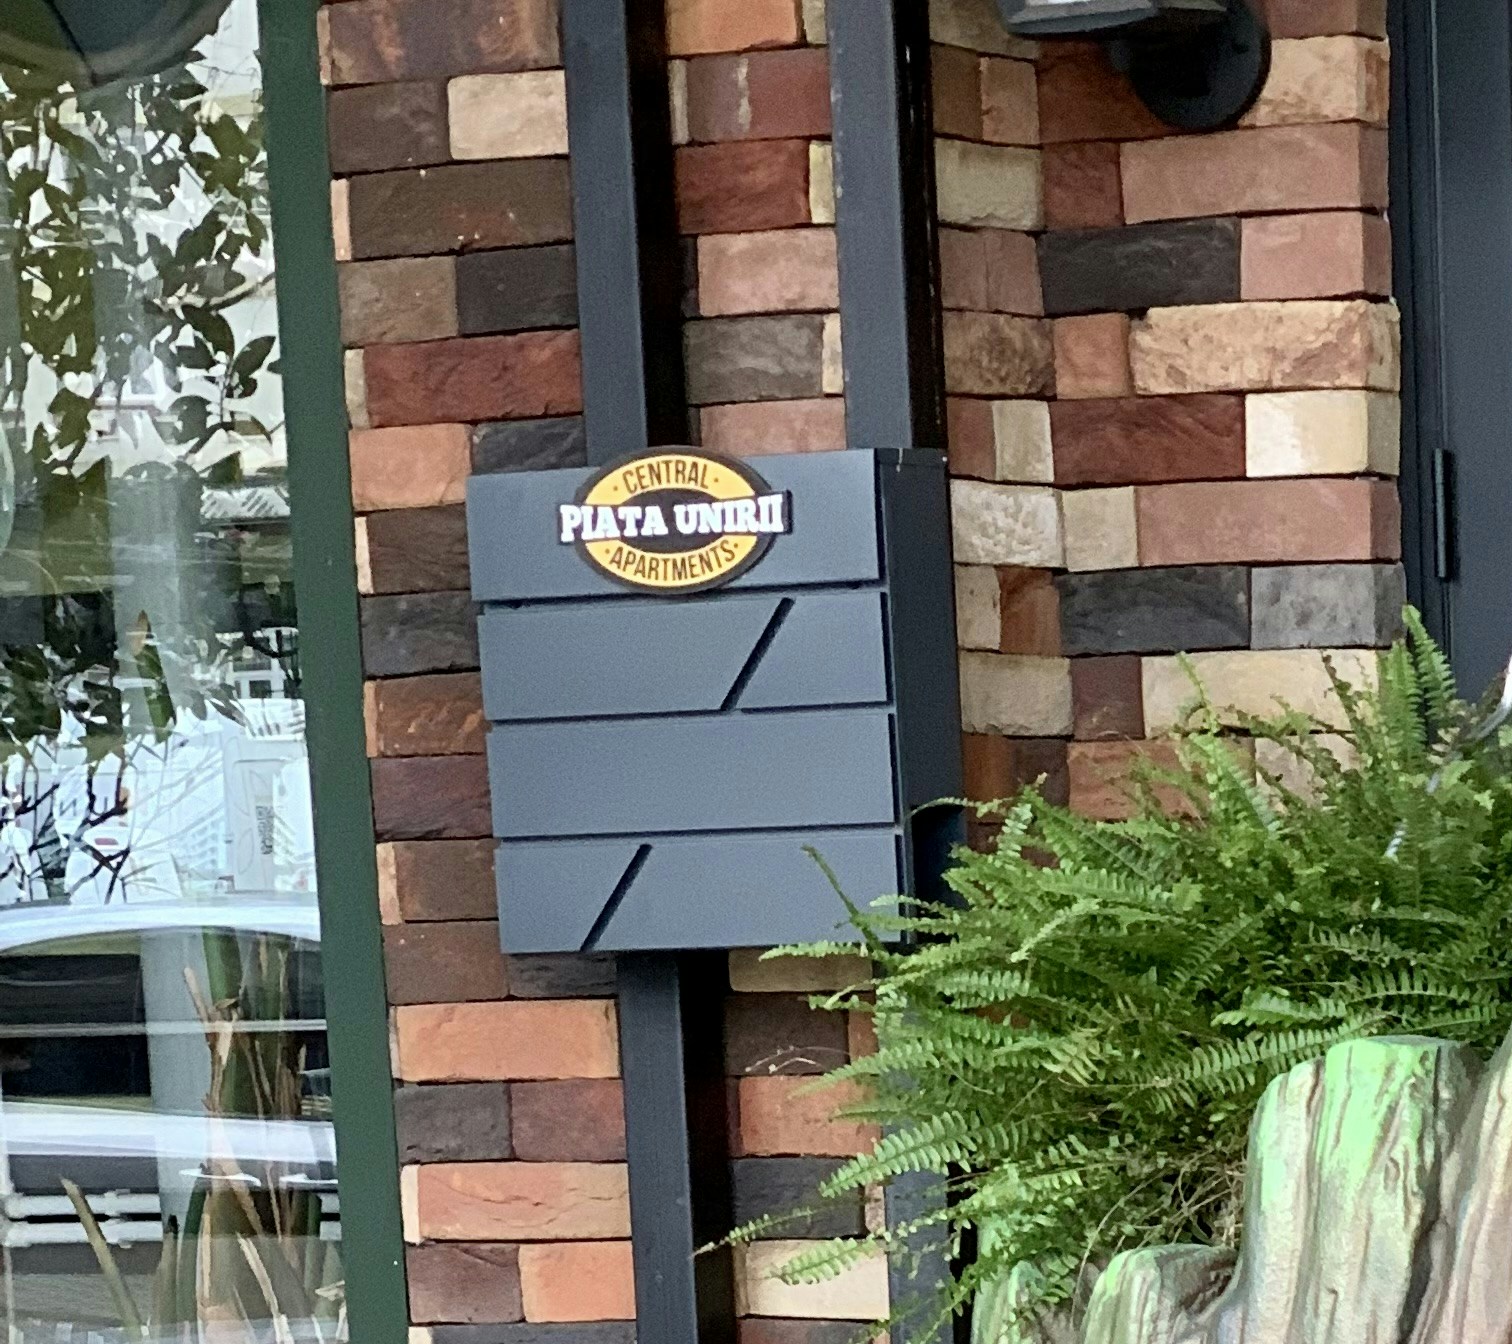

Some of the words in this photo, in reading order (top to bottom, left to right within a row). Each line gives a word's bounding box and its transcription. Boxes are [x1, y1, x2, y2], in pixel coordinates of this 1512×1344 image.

[622, 459, 709, 494] CENTRAL
[560, 504, 669, 542] PIATA
[673, 494, 784, 535] UNIRII
[609, 539, 736, 582] APARTMENTS
